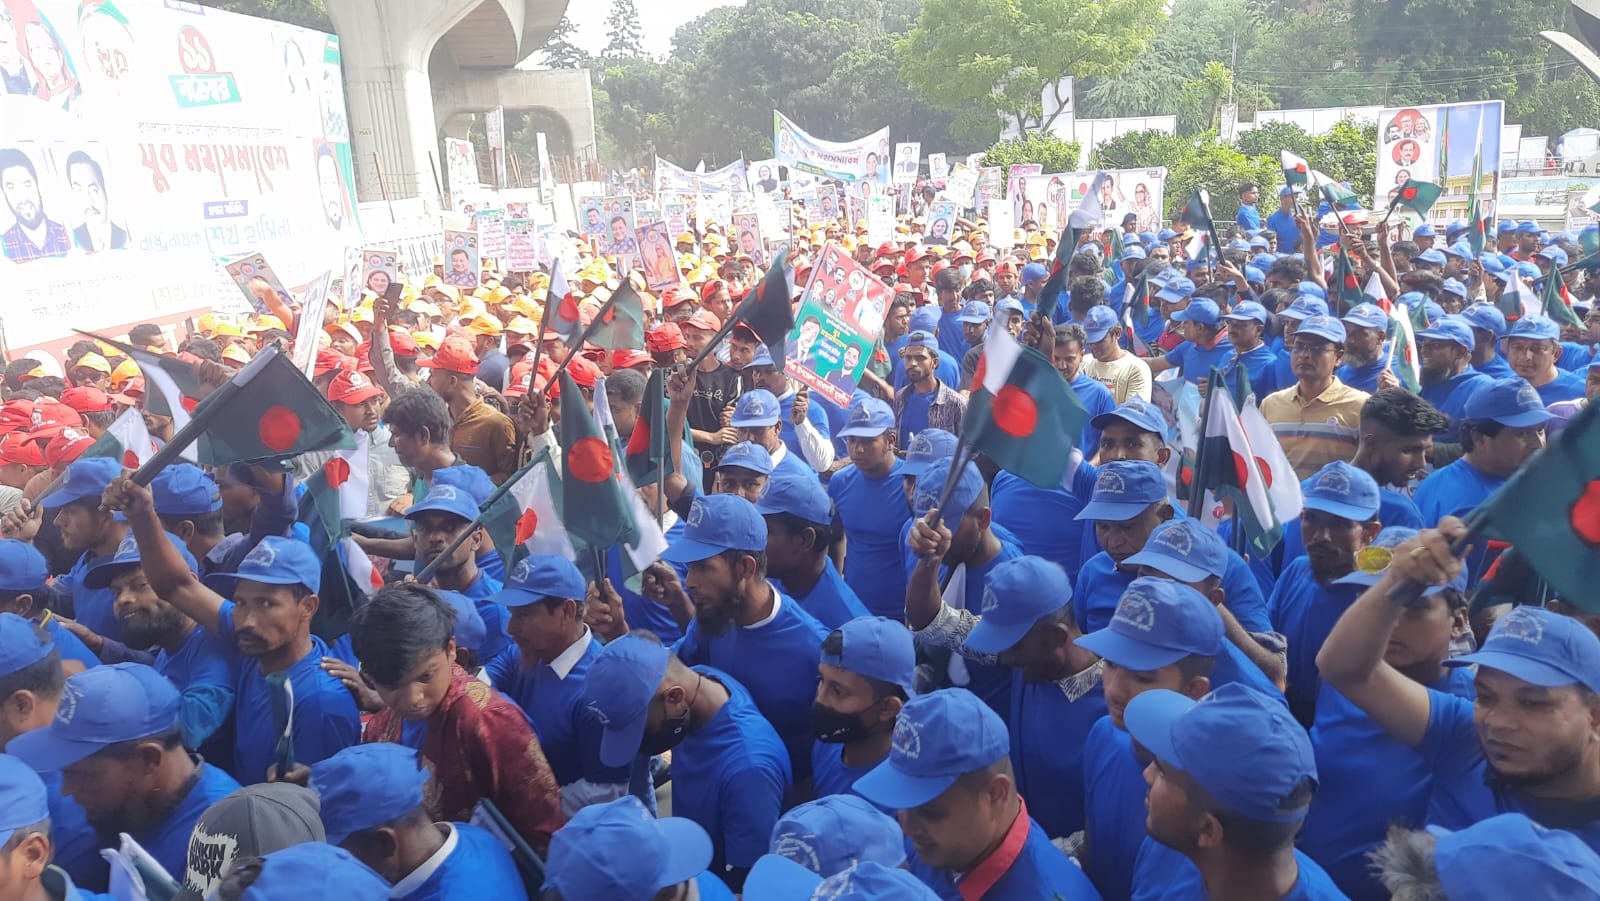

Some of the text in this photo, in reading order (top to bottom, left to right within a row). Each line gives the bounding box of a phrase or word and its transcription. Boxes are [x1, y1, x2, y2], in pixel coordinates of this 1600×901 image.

[137, 143, 290, 197] যুব মহাসমাবেশ
[204, 223, 240, 254] শেখ
[244, 213, 292, 245] হাসিনা
[189, 834, 226, 889] LINKIN PARK
